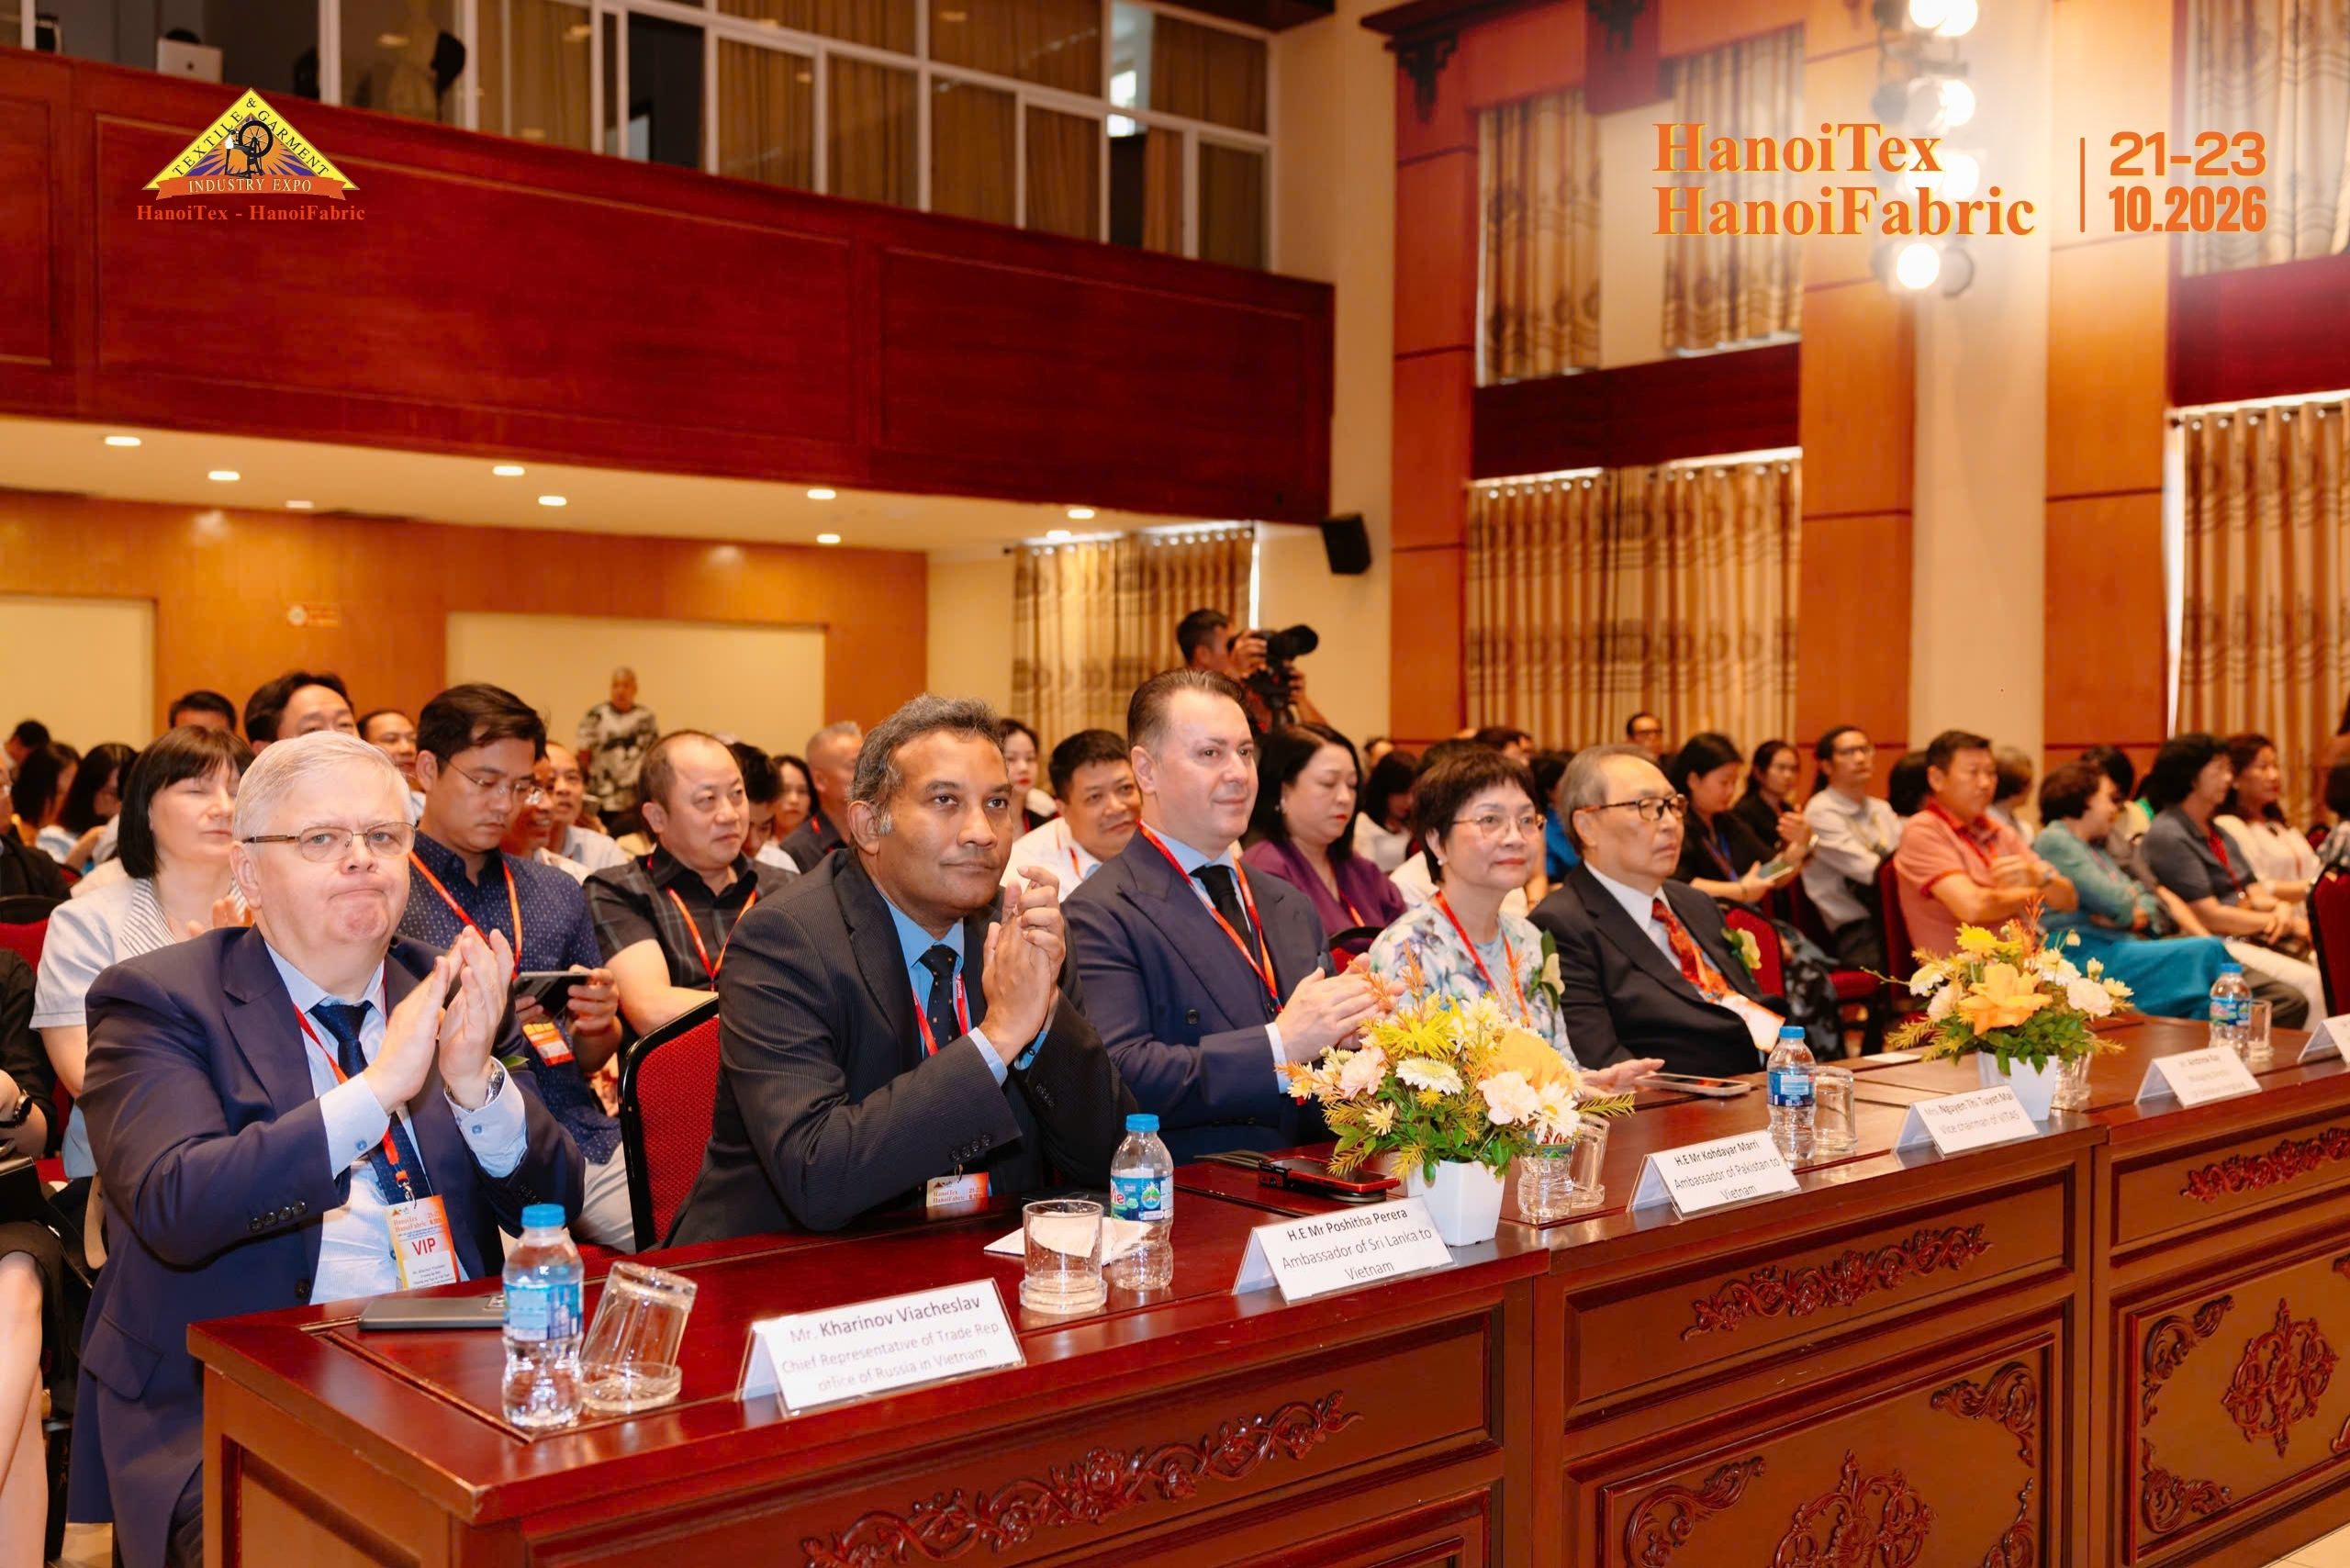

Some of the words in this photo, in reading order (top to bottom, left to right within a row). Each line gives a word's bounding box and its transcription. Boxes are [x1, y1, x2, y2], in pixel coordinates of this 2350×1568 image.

[1674, 1156, 1690, 1166] H.E
[1690, 1154, 1701, 1163] Mr
[1737, 1139, 1760, 1151] Marri
[1674, 1170, 1725, 1190] Ambassador
[1726, 1168, 1735, 1178] of
[1736, 1159, 1770, 1175] Pakistan
[1770, 1157, 1780, 1167] to
[1720, 1184, 1757, 1201] Vietnam
[1286, 1226, 1307, 1241] H.E
[1308, 1225, 1324, 1237] Mr
[1326, 1215, 1372, 1234] Poshitha
[1372, 1207, 1408, 1224] Perera
[411, 1238, 436, 1256] VIP
[1282, 1245, 1353, 1270] Ambassador
[1355, 1239, 1367, 1254] of
[1371, 1237, 1385, 1250] Sri
[1387, 1229, 1418, 1247] Lanka
[1418, 1227, 1432, 1239] to
[1345, 1261, 1394, 1281] Vietnam
[789, 1328, 818, 1343] Mr.
[820, 1314, 894, 1338] Kharinov
[896, 1295, 980, 1323] Viacheslav
[781, 1356, 816, 1374] Chief
[820, 1337, 919, 1371] Representative
[921, 1333, 935, 1348] of
[937, 1326, 973, 1344] Trade
[976, 1321, 1000, 1338] Rep
[859, 1369, 873, 1383] of
[876, 1361, 917, 1380] Russia
[919, 1356, 932, 1371] in
[933, 1345, 988, 1368] Vietnam
